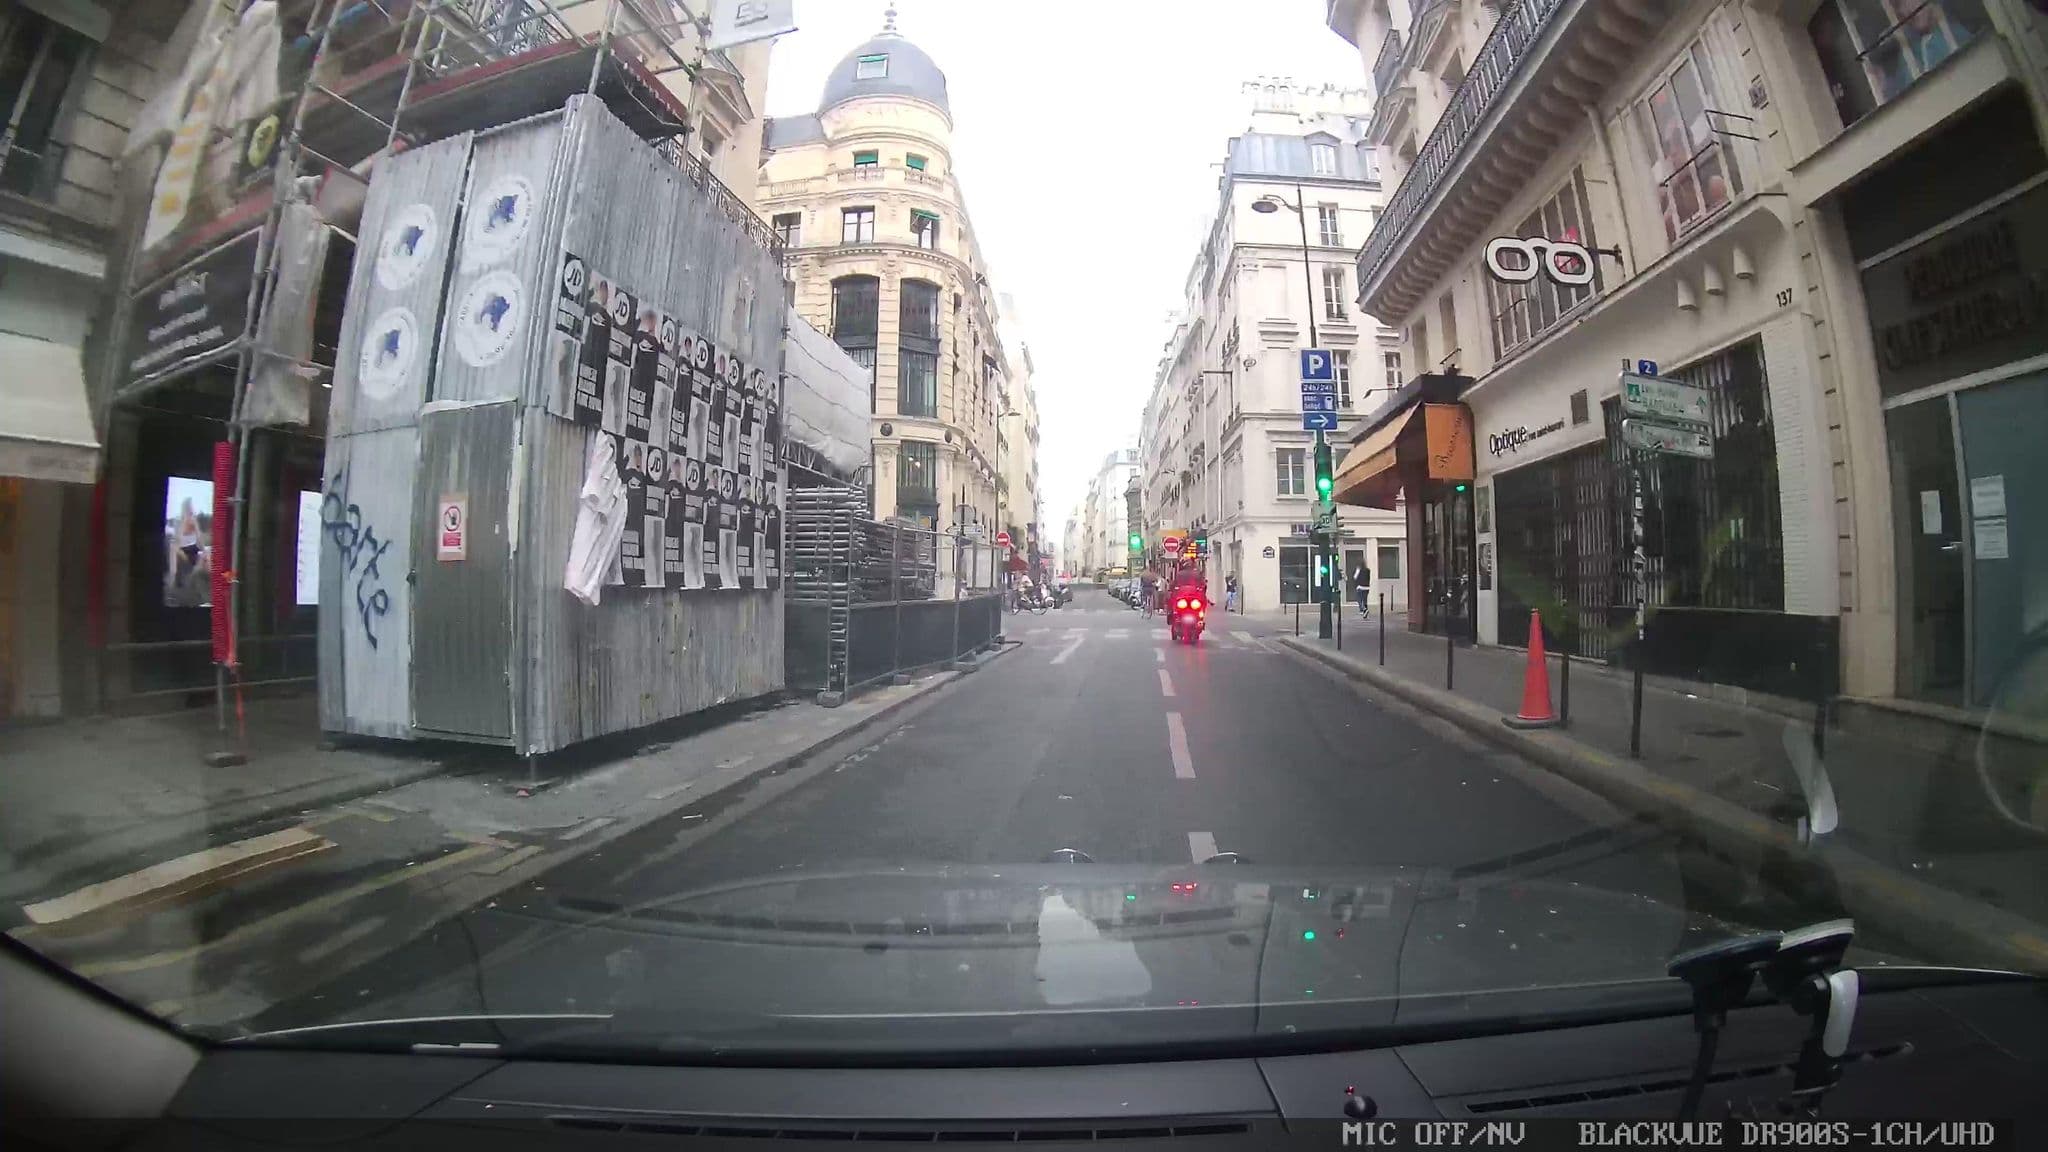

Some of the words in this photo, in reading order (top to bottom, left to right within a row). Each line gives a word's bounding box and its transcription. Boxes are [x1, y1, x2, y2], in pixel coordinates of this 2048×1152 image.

[567, 268, 583, 287] JD
[1776, 287, 1793, 308] 137
[615, 300, 628, 318] JD
[696, 346, 708, 362] JD
[1309, 354, 1324, 375] P
[1643, 361, 1652, 374] 2
[1489, 425, 1528, 457] Optique
[651, 456, 661, 472] JD
[687, 467, 698, 482] JD
